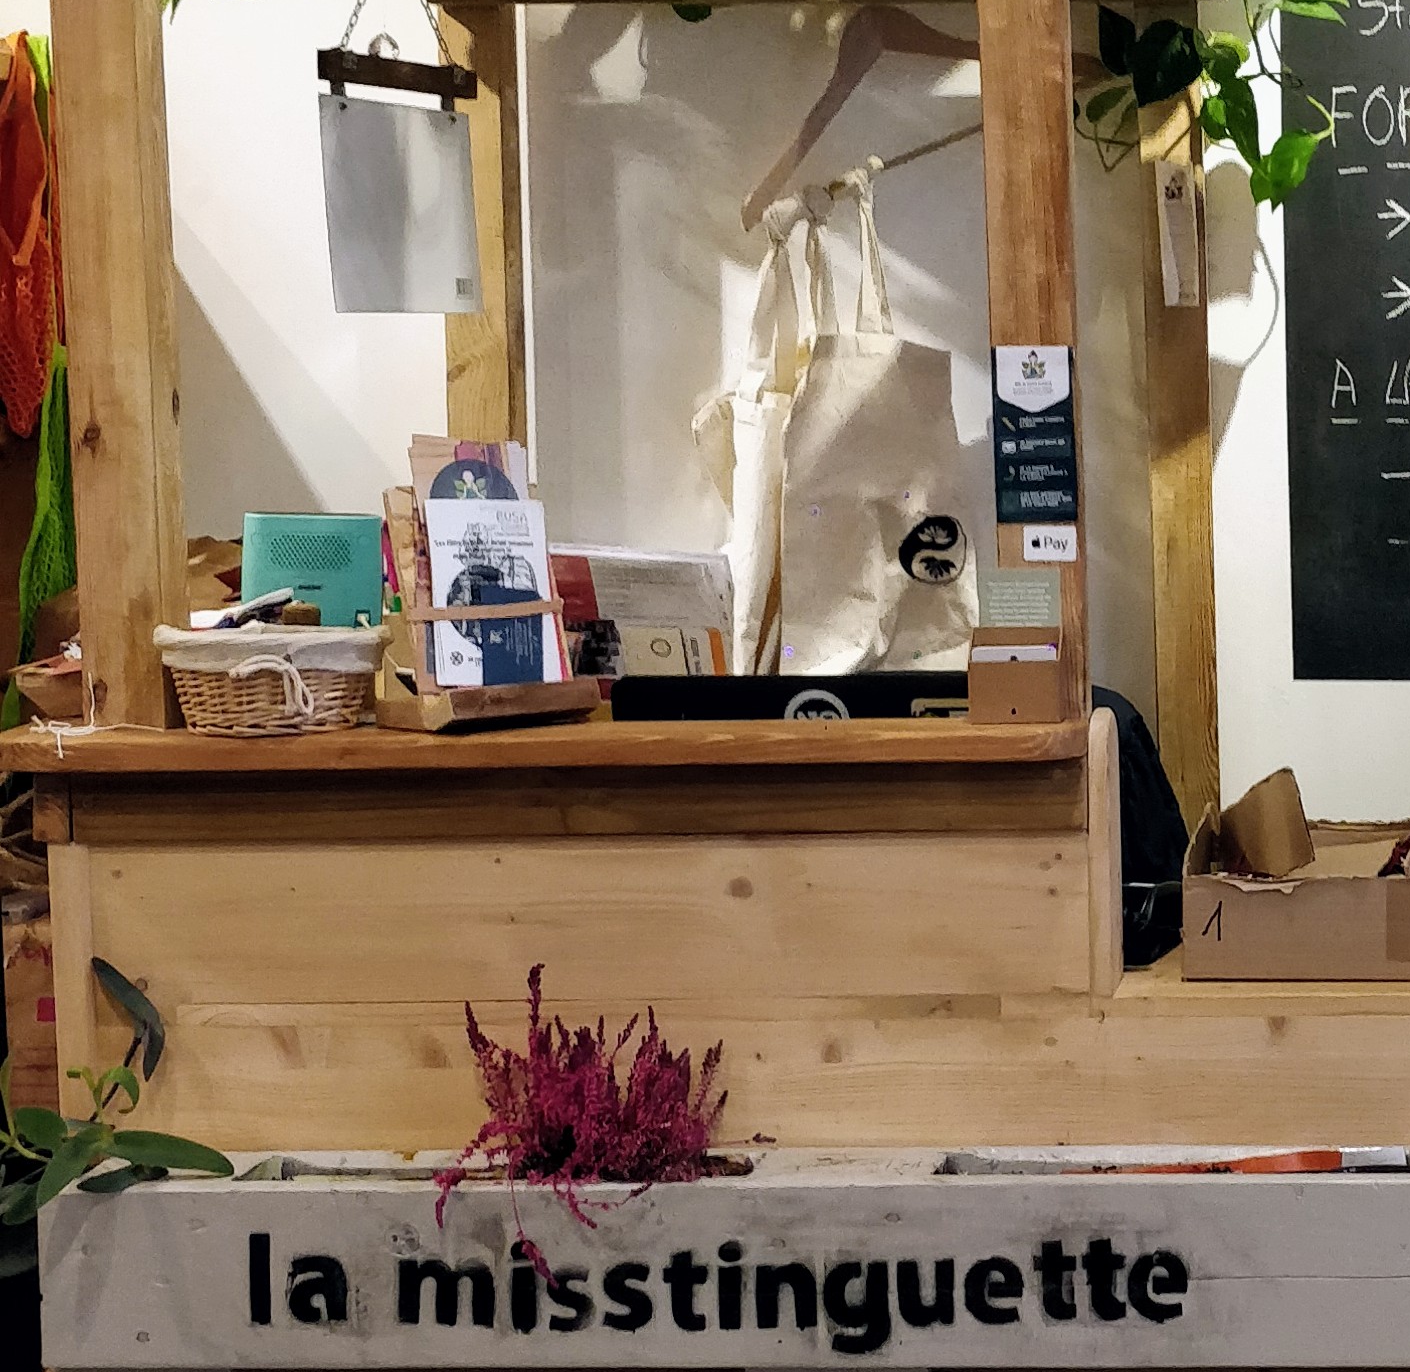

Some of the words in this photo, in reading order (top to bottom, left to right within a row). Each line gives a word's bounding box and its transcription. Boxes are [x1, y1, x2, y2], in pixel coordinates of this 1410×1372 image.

[1331, 358, 1357, 409] A
[1044, 536, 1069, 554] Pay
[1202, 900, 1222, 942] 1
[244, 1233, 349, 1327] la
[397, 1235, 1189, 1356] misstinguette
